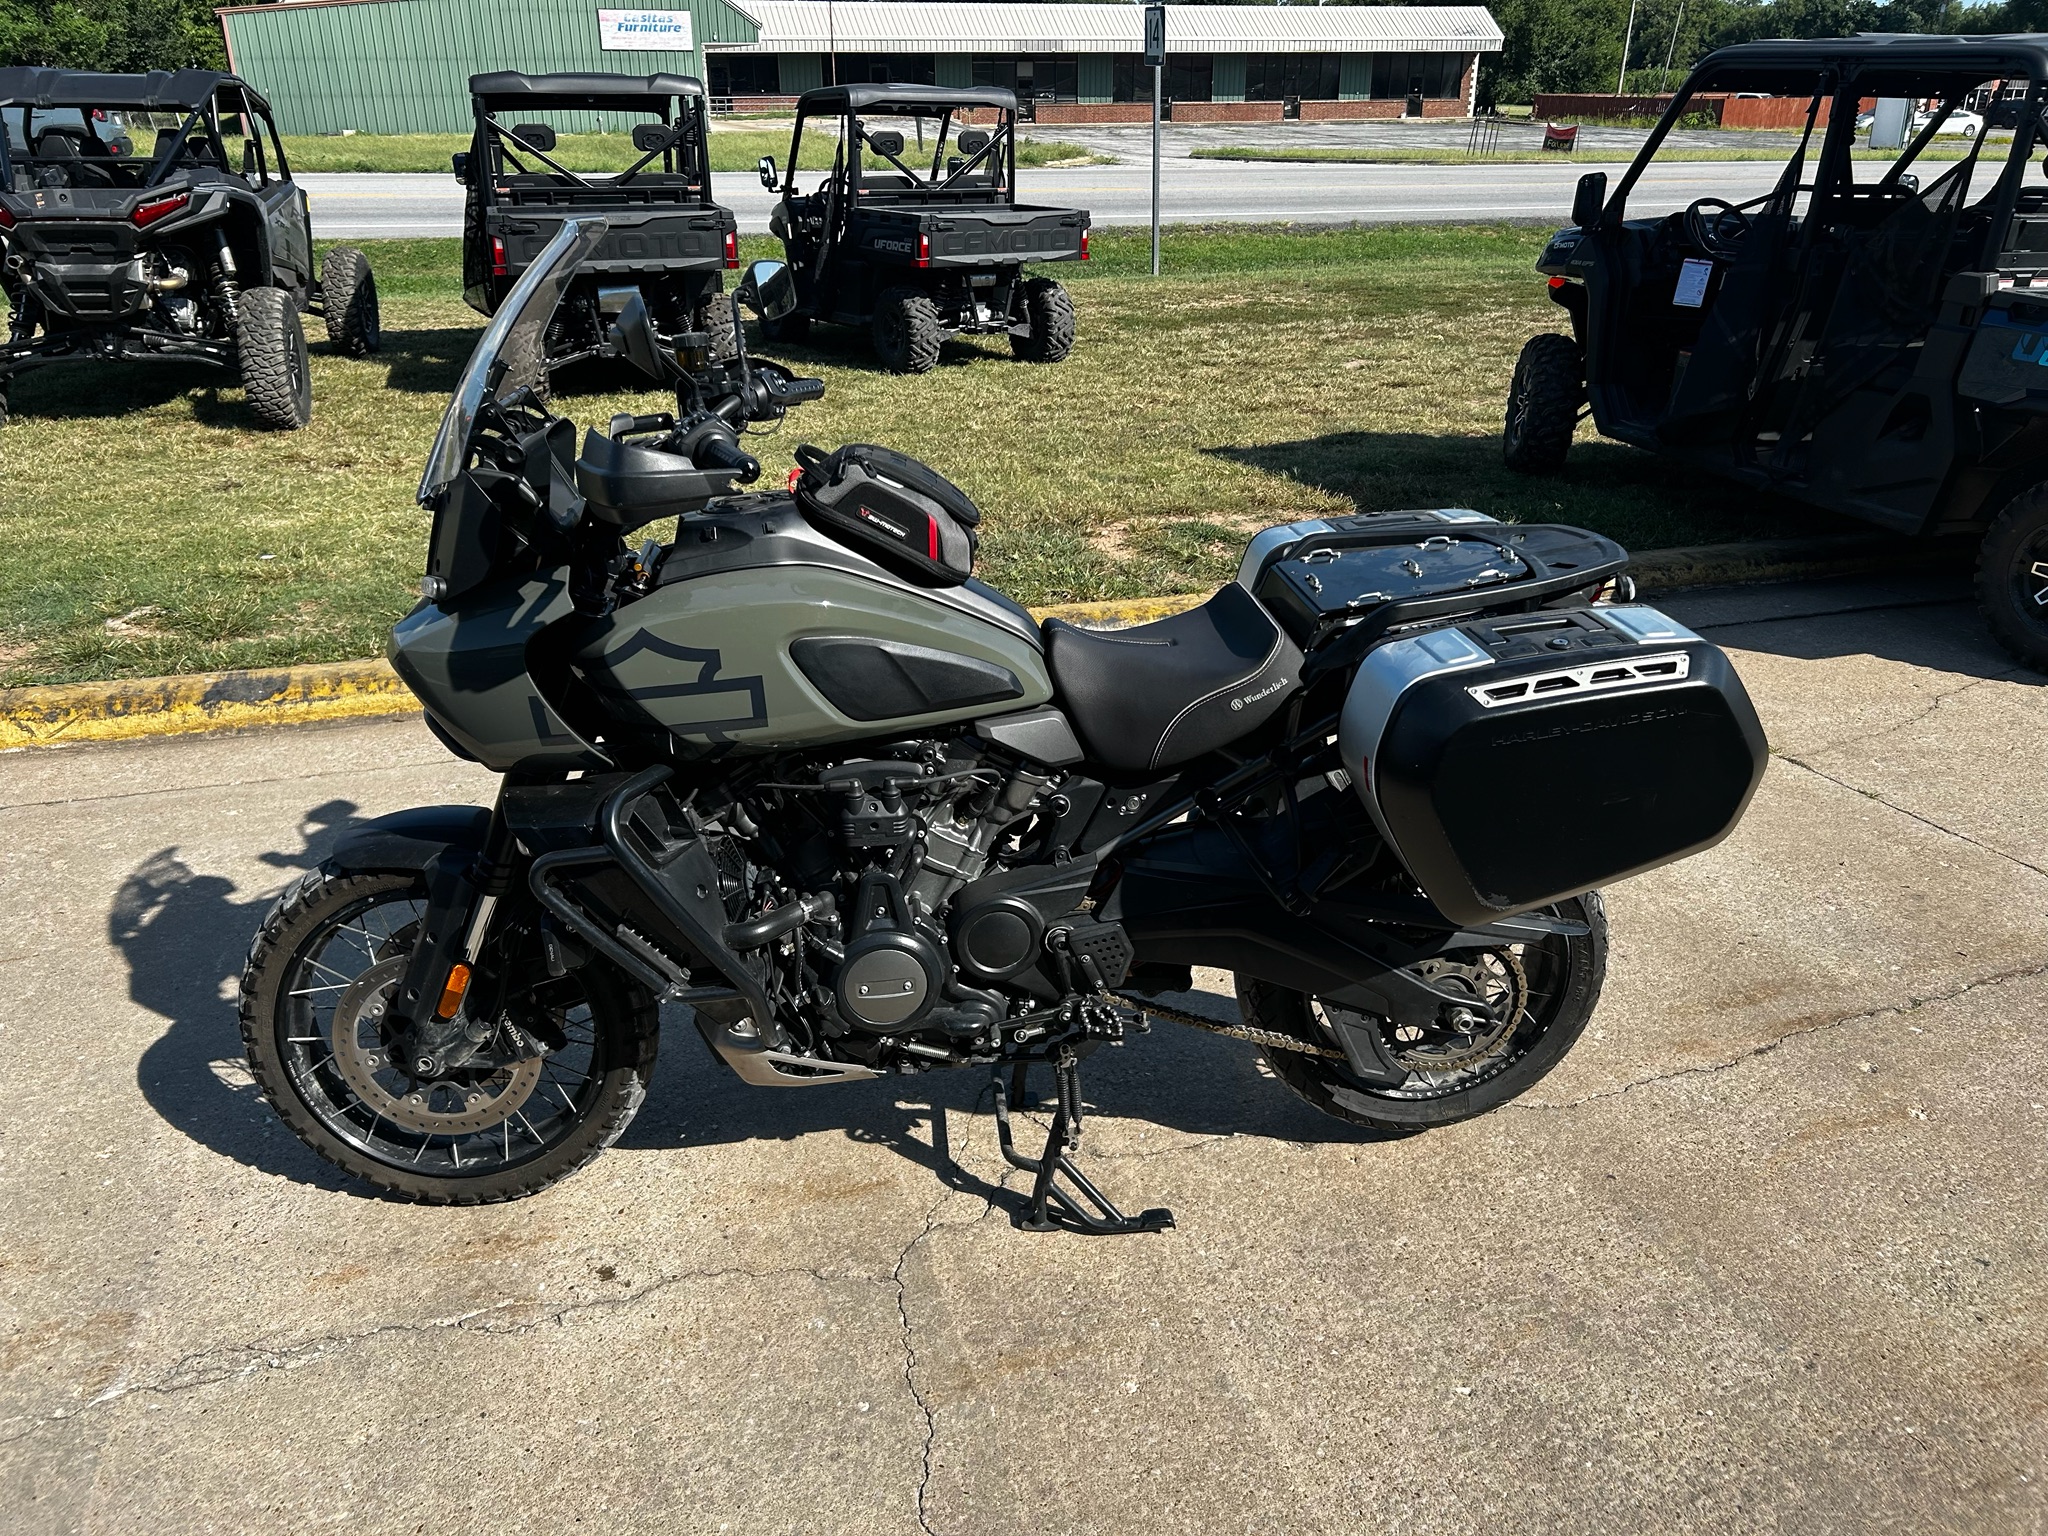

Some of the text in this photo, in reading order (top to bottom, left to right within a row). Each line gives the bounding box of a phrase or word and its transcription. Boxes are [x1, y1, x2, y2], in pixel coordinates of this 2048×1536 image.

[617, 22, 682, 33] Furniture
[624, 13, 673, 23] Casitas
[1149, 17, 1160, 49] 14
[874, 239, 912, 253] UFORCE
[943, 228, 1069, 254] CFMOTO
[1243, 677, 1288, 704] Wunderlich
[1491, 705, 1688, 747] HARLEY-DAVIDSON
